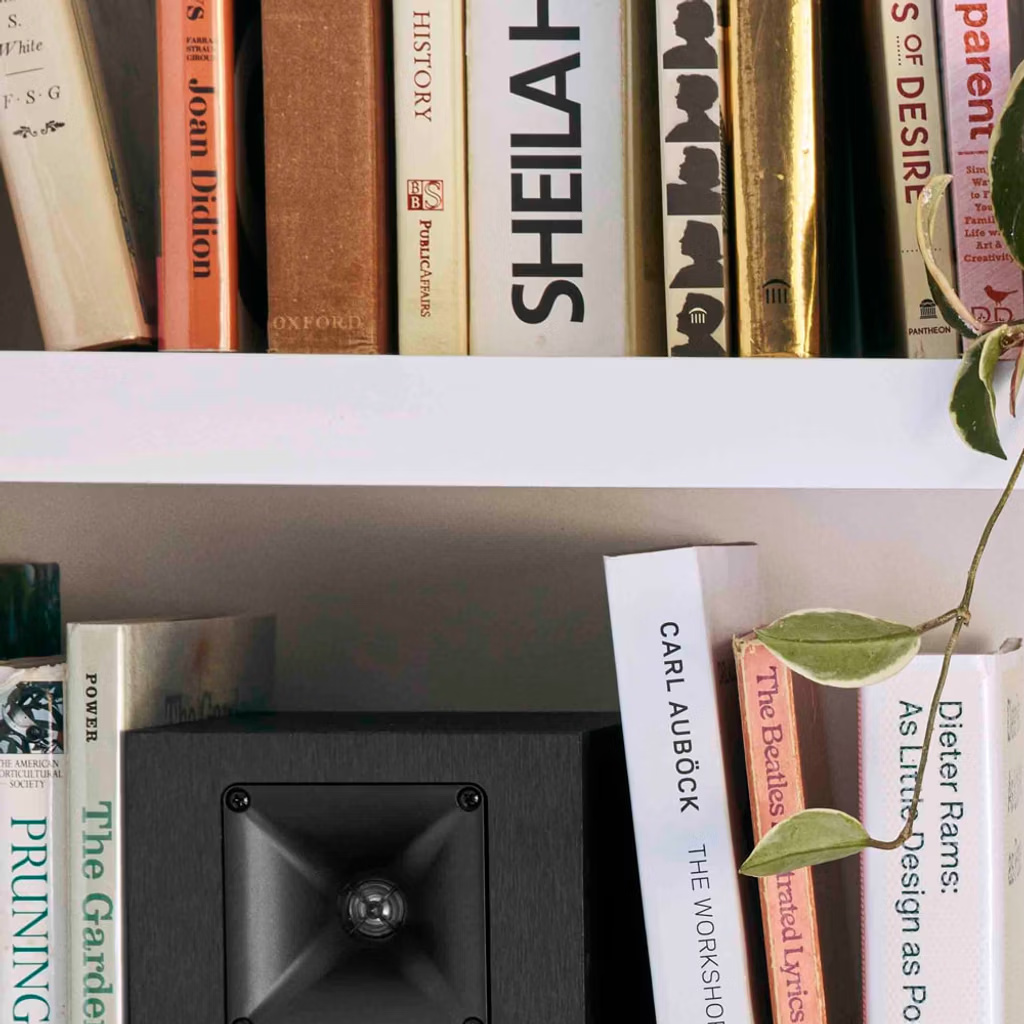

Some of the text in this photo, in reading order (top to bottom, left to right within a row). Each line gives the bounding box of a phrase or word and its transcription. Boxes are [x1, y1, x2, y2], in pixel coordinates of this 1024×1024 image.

[413, 10, 432, 122] HISTORY
[903, 34, 924, 66] OF
[955, 3, 995, 140] parent
[896, 77, 932, 204] DESIRE
[189, 78, 219, 279] Joan Didion
[508, 52, 585, 324] SHEILA
[964, 217, 996, 225] Famil
[964, 229, 985, 238] Life
[975, 240, 991, 249] Art
[273, 315, 363, 330] OXFORD
[908, 324, 951, 336] PANTHEON
[85, 673, 97, 743] POWER
[659, 621, 699, 812] CARL AUBÖCK
[757, 665, 779, 720] The
[899, 701, 923, 736] As
[0, 760, 11, 768] HE
[9, 780, 44, 788] SOCIETY
[761, 724, 788, 816] Beatles
[939, 701, 964, 894] Dieter Rams:
[82, 801, 113, 880] The
[688, 843, 711, 891] THE
[895, 832, 925, 933] Design
[10, 816, 52, 1024] PRUNING
[780, 946, 805, 1023] Lyrics
[901, 950, 921, 976] as
